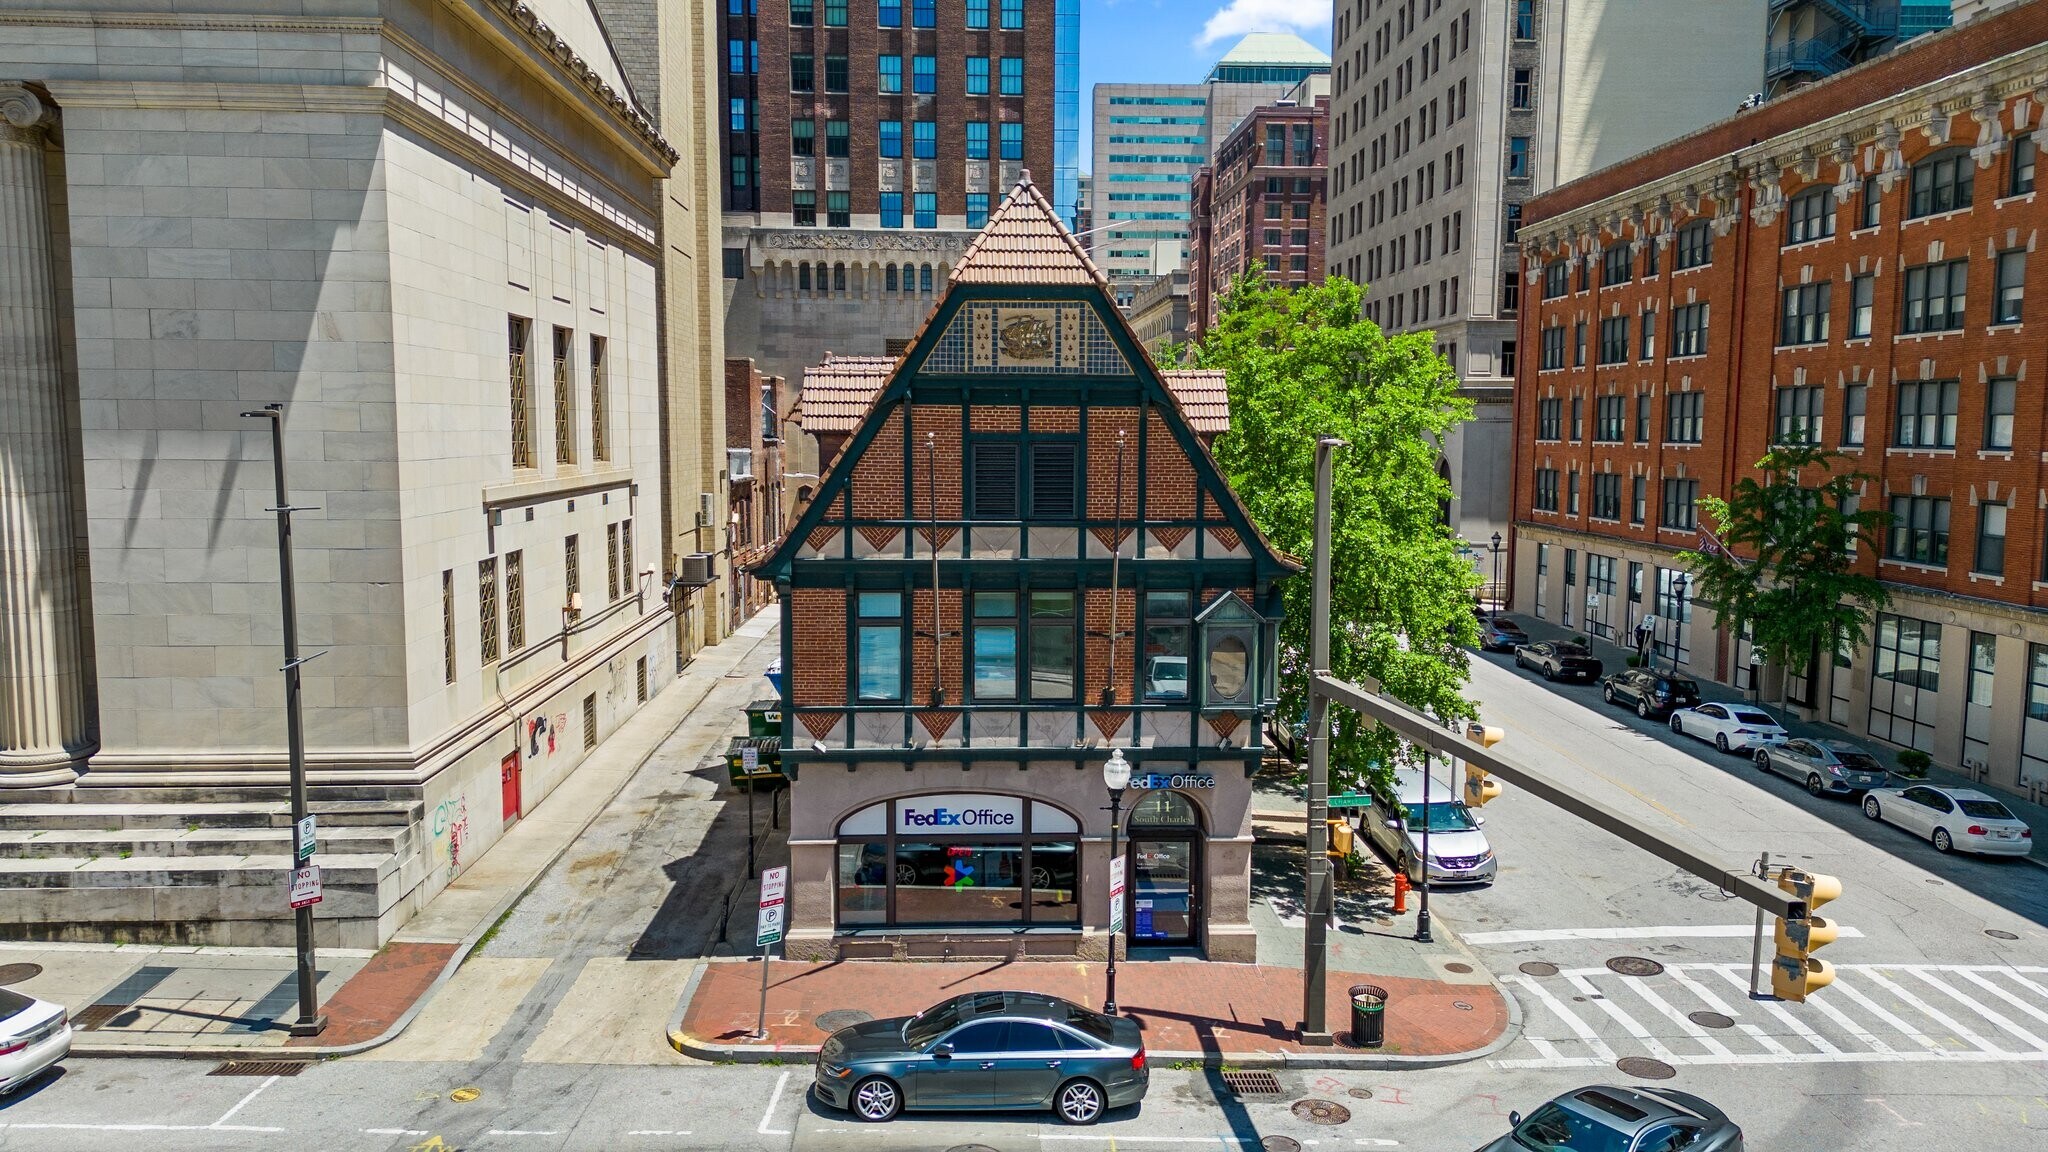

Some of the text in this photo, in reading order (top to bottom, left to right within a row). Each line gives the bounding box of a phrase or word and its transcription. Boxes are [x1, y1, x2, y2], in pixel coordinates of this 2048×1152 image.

[1128, 774, 1215, 789] edEx Office
[1155, 800, 1171, 813] 11
[904, 808, 1014, 826] FedEx Office
[1134, 814, 1192, 823] South Charles
[946, 846, 973, 857] OPEN
[297, 870, 311, 880] NO
[769, 871, 780, 880] NO
[291, 879, 319, 892] STOPPING
[763, 880, 784, 891] STOPPING
